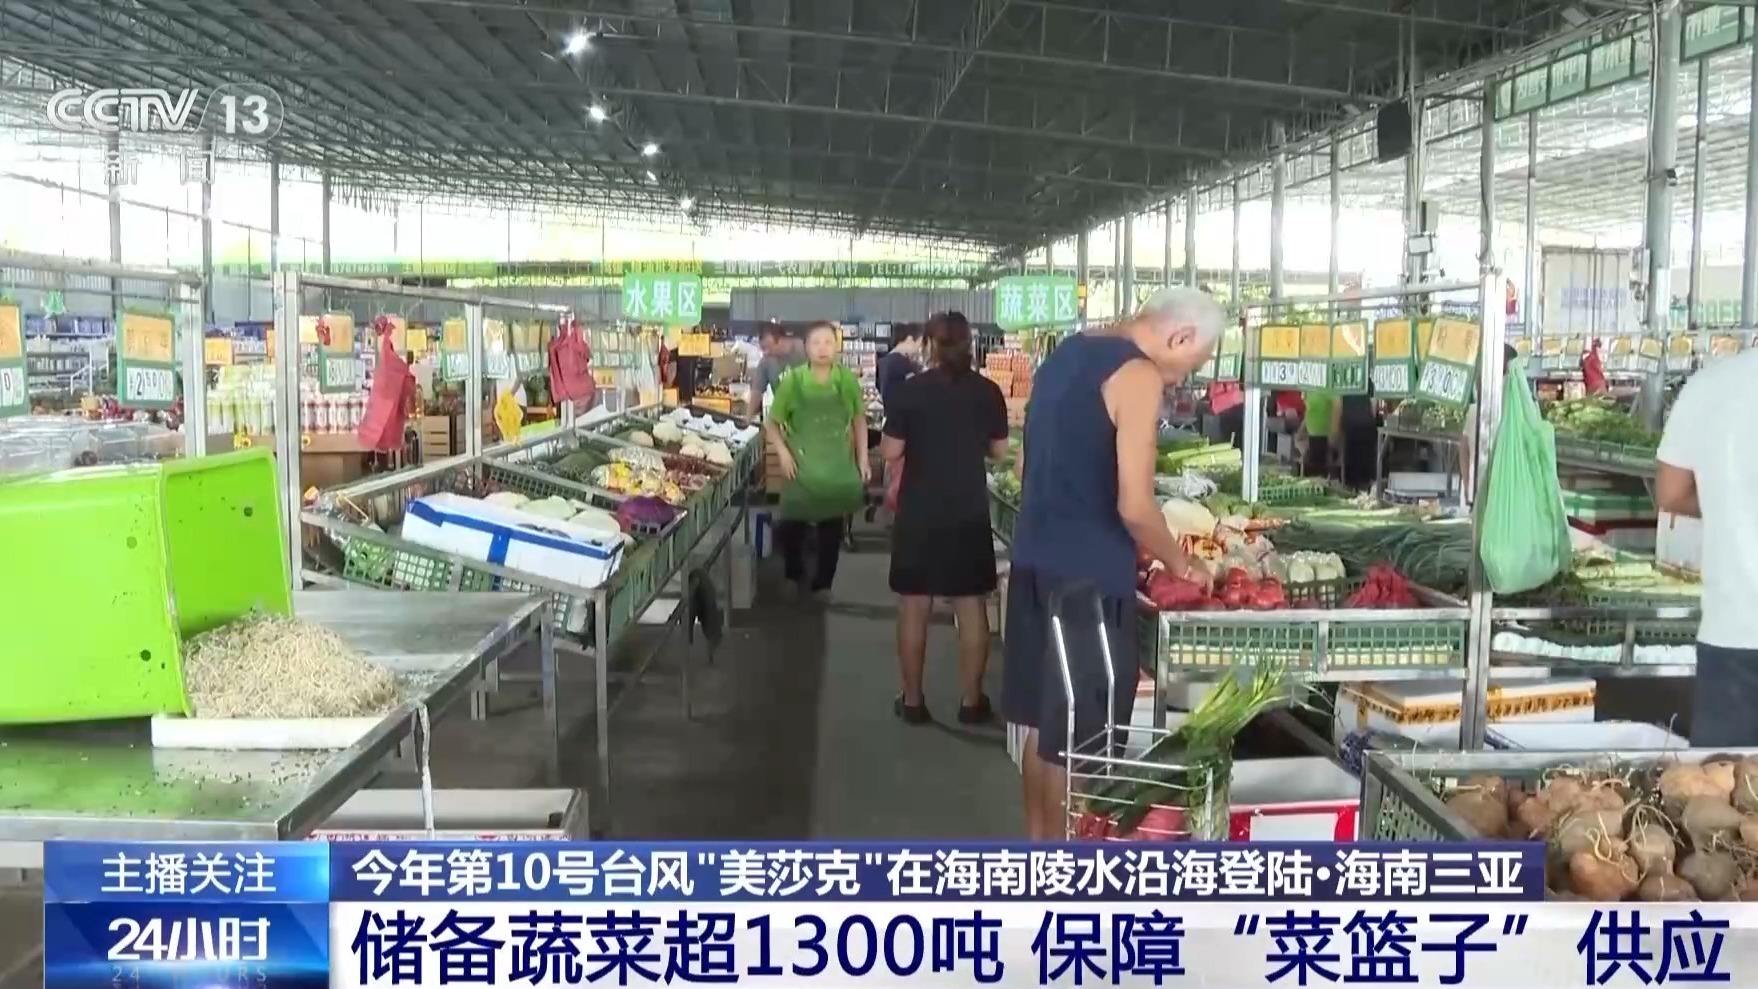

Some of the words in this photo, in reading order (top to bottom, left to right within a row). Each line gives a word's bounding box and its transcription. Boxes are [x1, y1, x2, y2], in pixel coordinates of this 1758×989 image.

[625, 280, 699, 318] 水果区
[999, 285, 1076, 321] 蔬菜区
